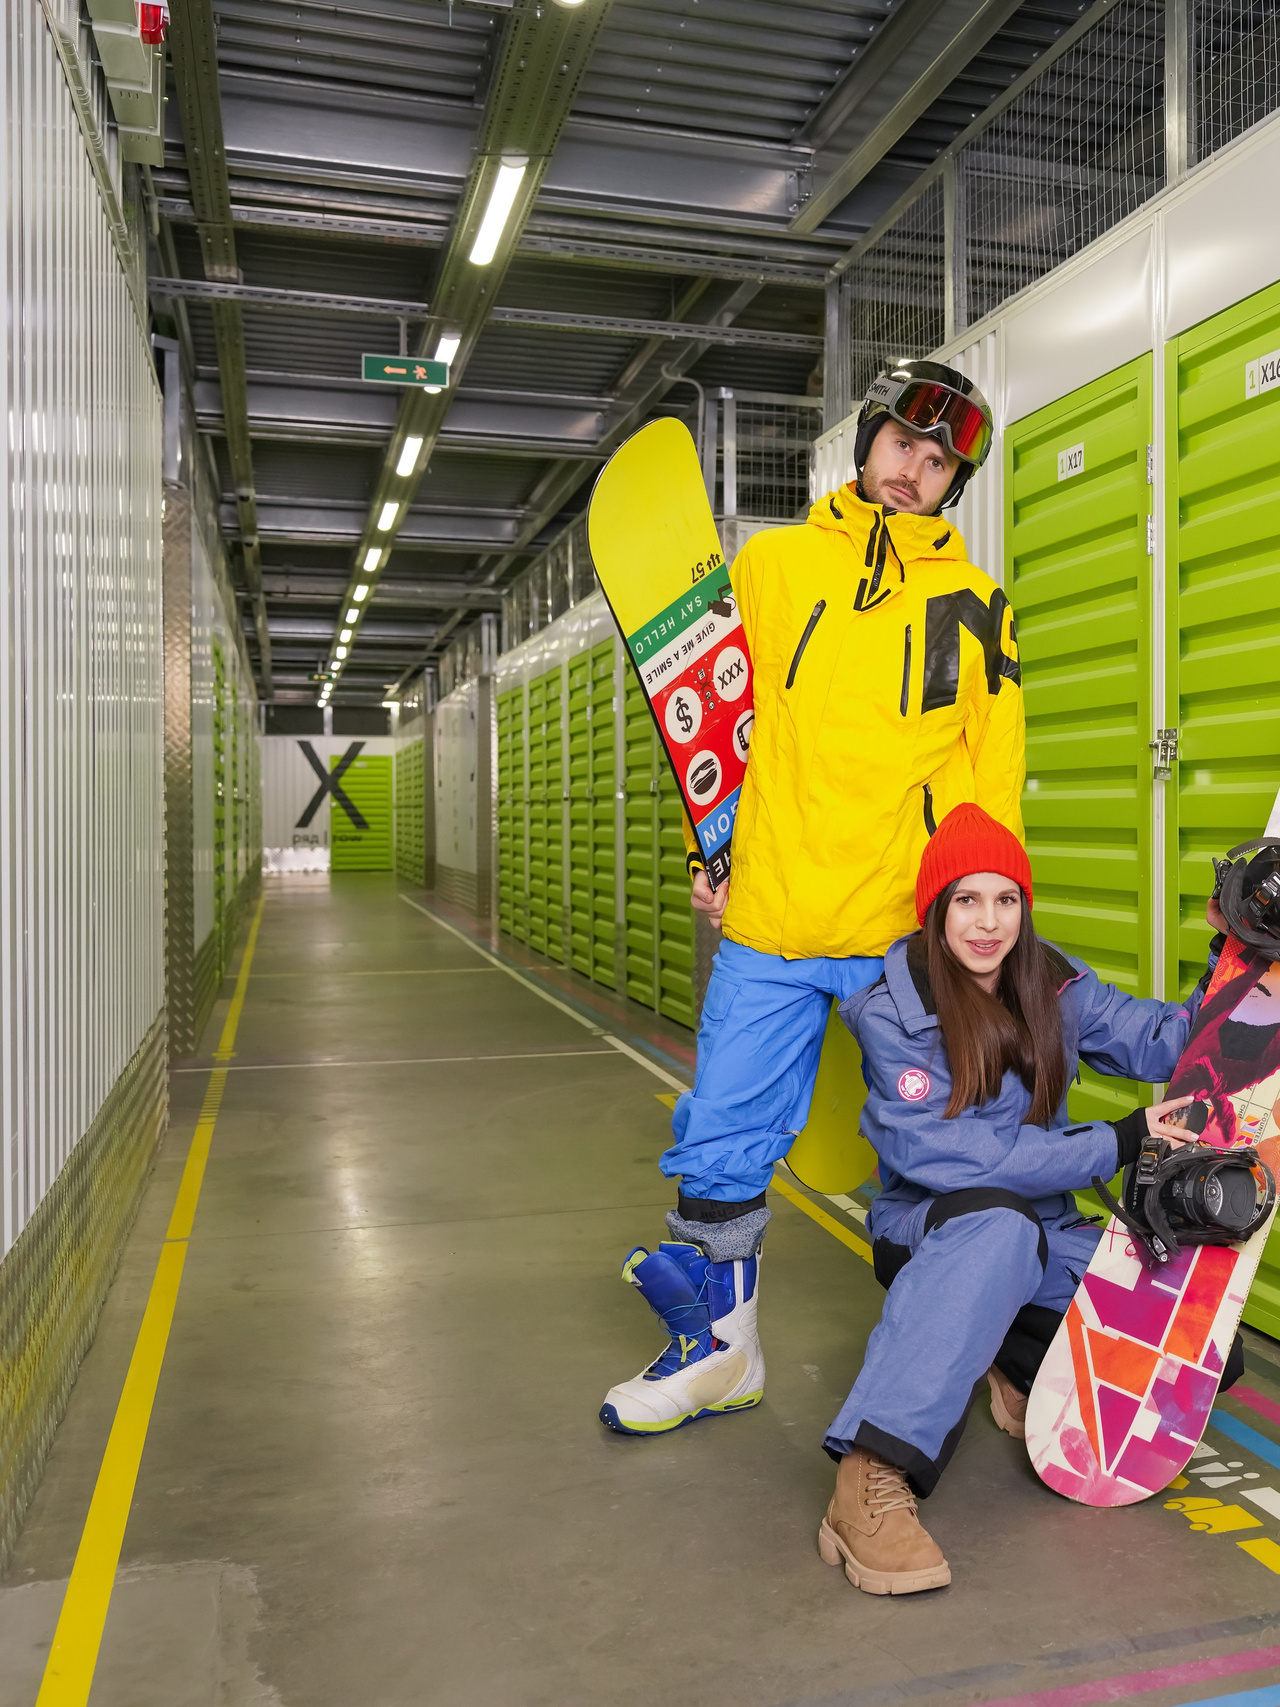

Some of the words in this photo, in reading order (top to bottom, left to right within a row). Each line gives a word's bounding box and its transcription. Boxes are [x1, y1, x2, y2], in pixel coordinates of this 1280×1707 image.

[868, 382, 890, 396] SMITH
[1248, 370, 1256, 390] 1
[1068, 450, 1083, 471] X17
[691, 562, 705, 584] 57
[681, 595, 702, 620] SAY
[635, 616, 676, 654] HELLO
[696, 622, 716, 644] GIVE
[674, 650, 680, 661] A
[682, 637, 696, 656] ME
[645, 657, 673, 685] SMILE
[717, 657, 745, 690] XXX
[295, 740, 370, 829] X
[1254, 1112, 1269, 1144] COUNTED
